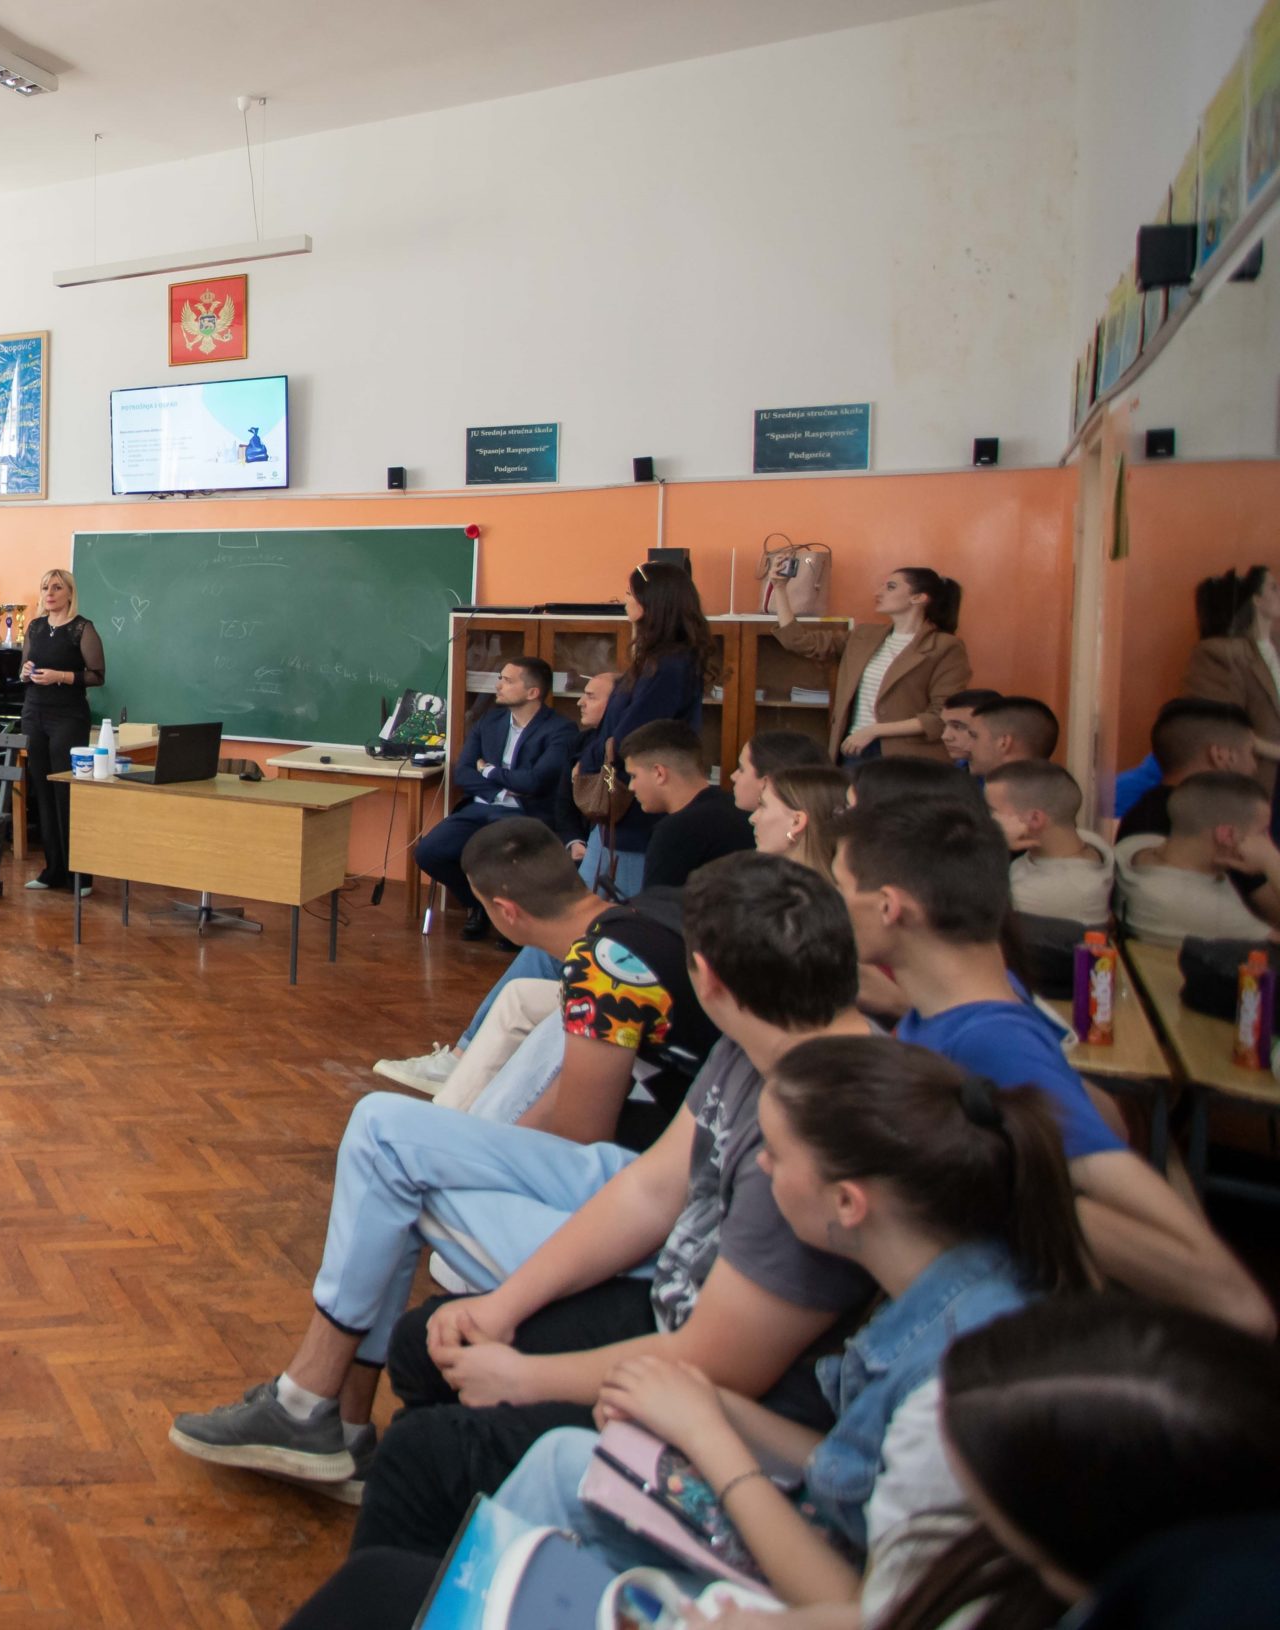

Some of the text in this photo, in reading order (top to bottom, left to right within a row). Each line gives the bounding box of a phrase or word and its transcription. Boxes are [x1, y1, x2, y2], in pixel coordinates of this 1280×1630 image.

[760, 412, 771, 420] JU
[773, 410, 805, 419] Srednja
[840, 406, 864, 415] škola
[481, 429, 507, 438] Srednja
[788, 451, 831, 460] Podgorica
[494, 465, 528, 473] Podgorica
